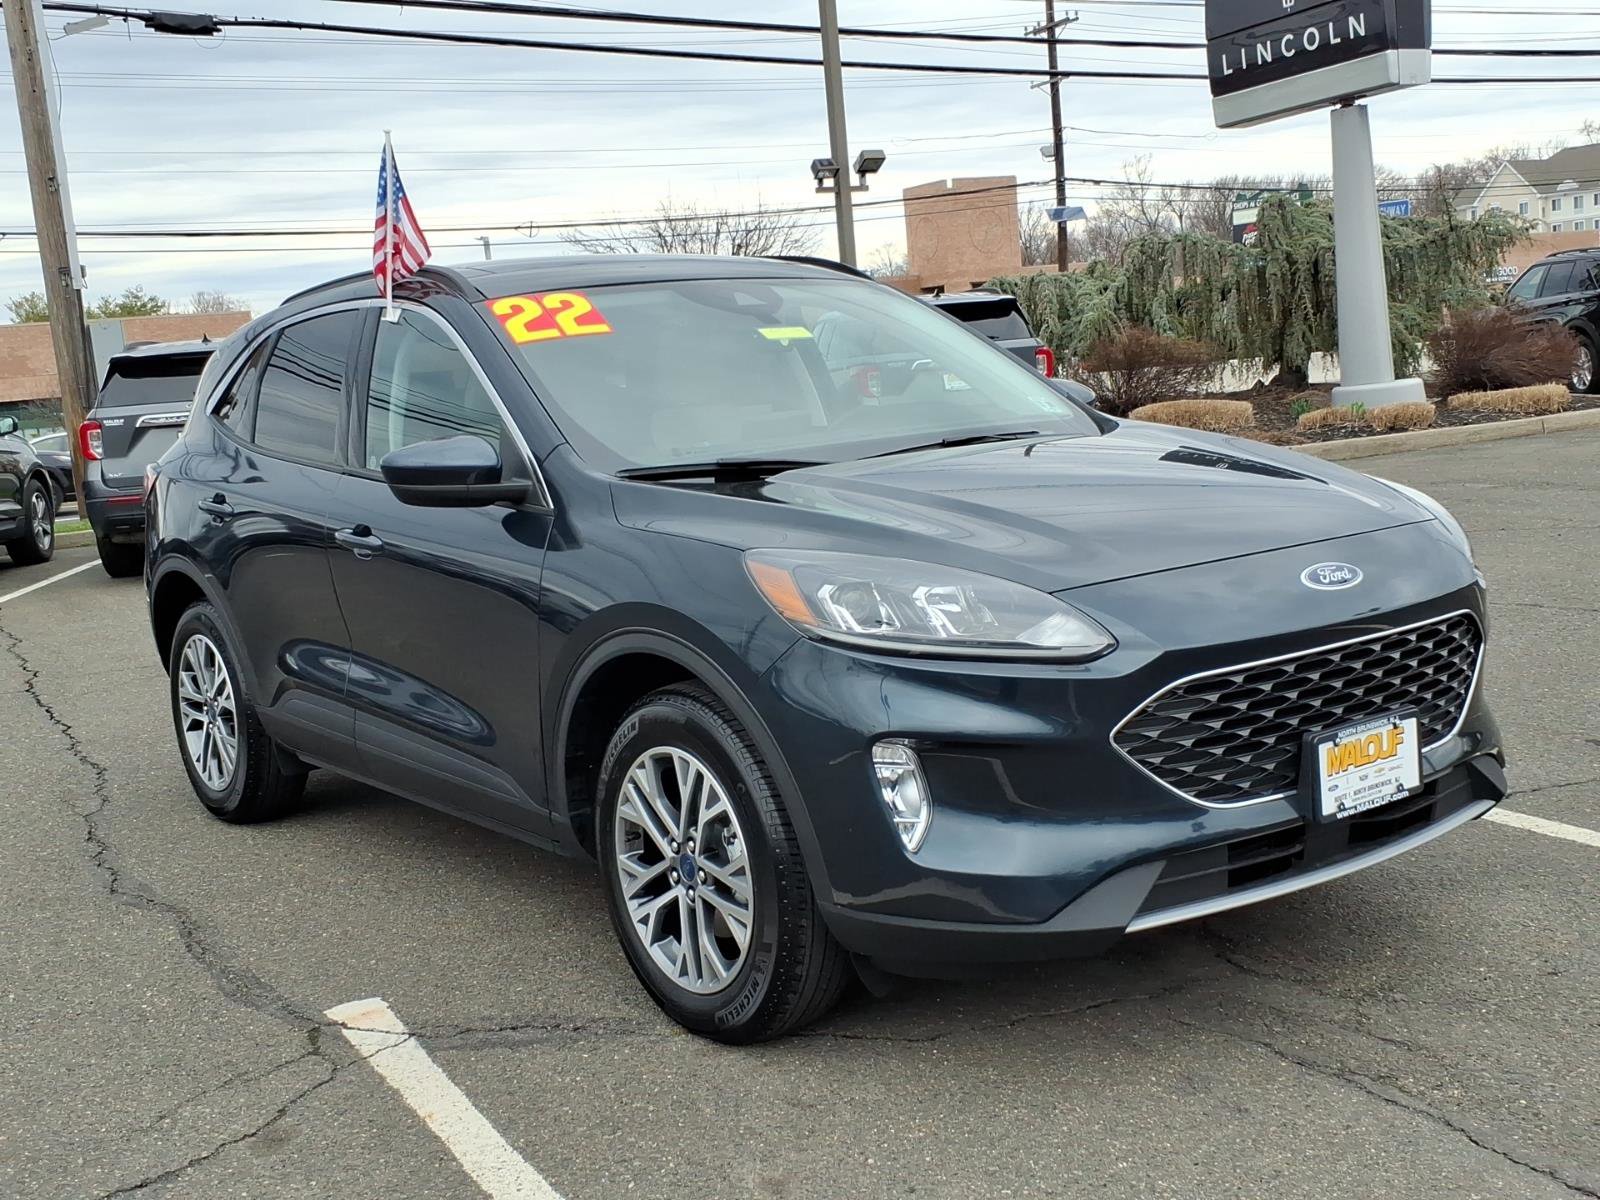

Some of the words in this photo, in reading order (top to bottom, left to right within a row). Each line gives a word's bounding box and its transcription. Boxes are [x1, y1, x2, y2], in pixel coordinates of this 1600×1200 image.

[1222, 13, 1366, 76] LINCOLN
[492, 292, 612, 344] 22
[1316, 566, 1352, 584] Ford
[1327, 726, 1404, 777] MALOUF
[1336, 791, 1409, 819] www.MALOUF.com
